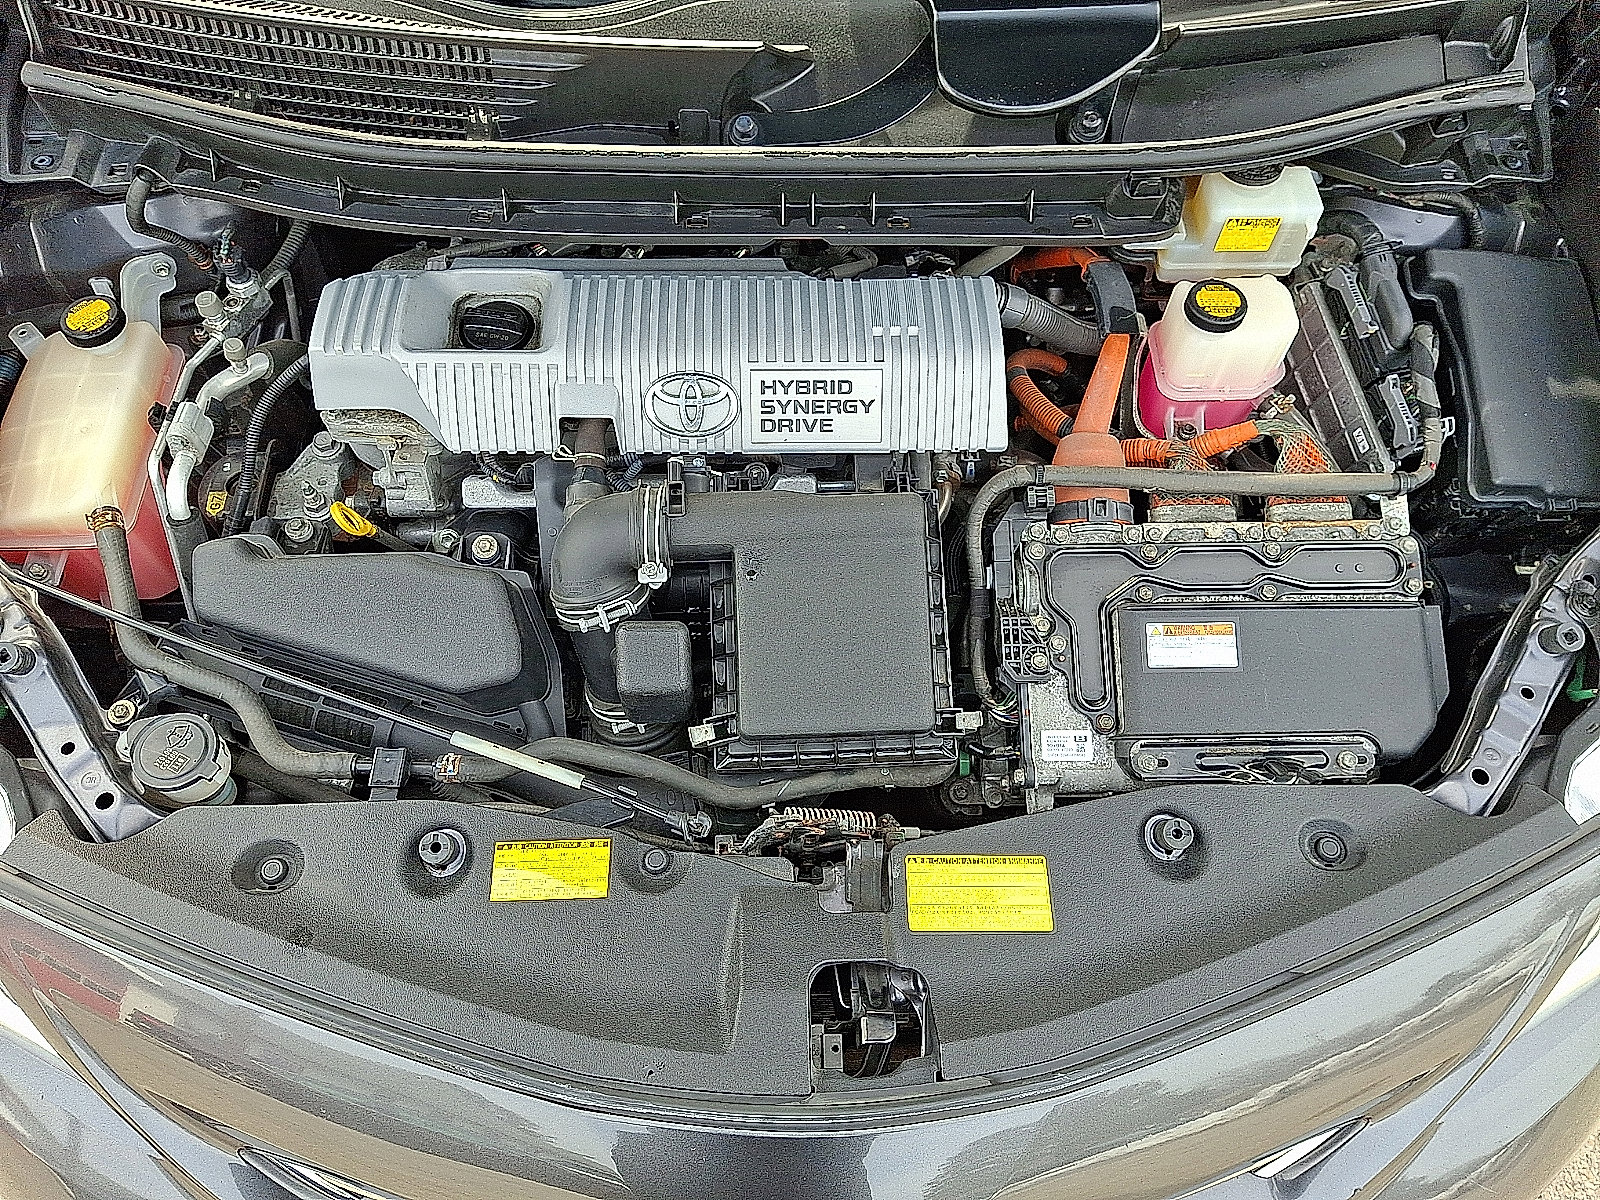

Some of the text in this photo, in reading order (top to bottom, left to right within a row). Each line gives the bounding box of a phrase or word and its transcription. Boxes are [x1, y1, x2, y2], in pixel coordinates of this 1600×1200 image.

[760, 379, 853, 395] HYBRID
[760, 399, 876, 415] SYNERGY
[760, 418, 834, 433] DRIVE
[525, 842, 547, 850] CAUTION
[933, 857, 961, 865] CAUTION
[967, 857, 1002, 865] ATTENTION
